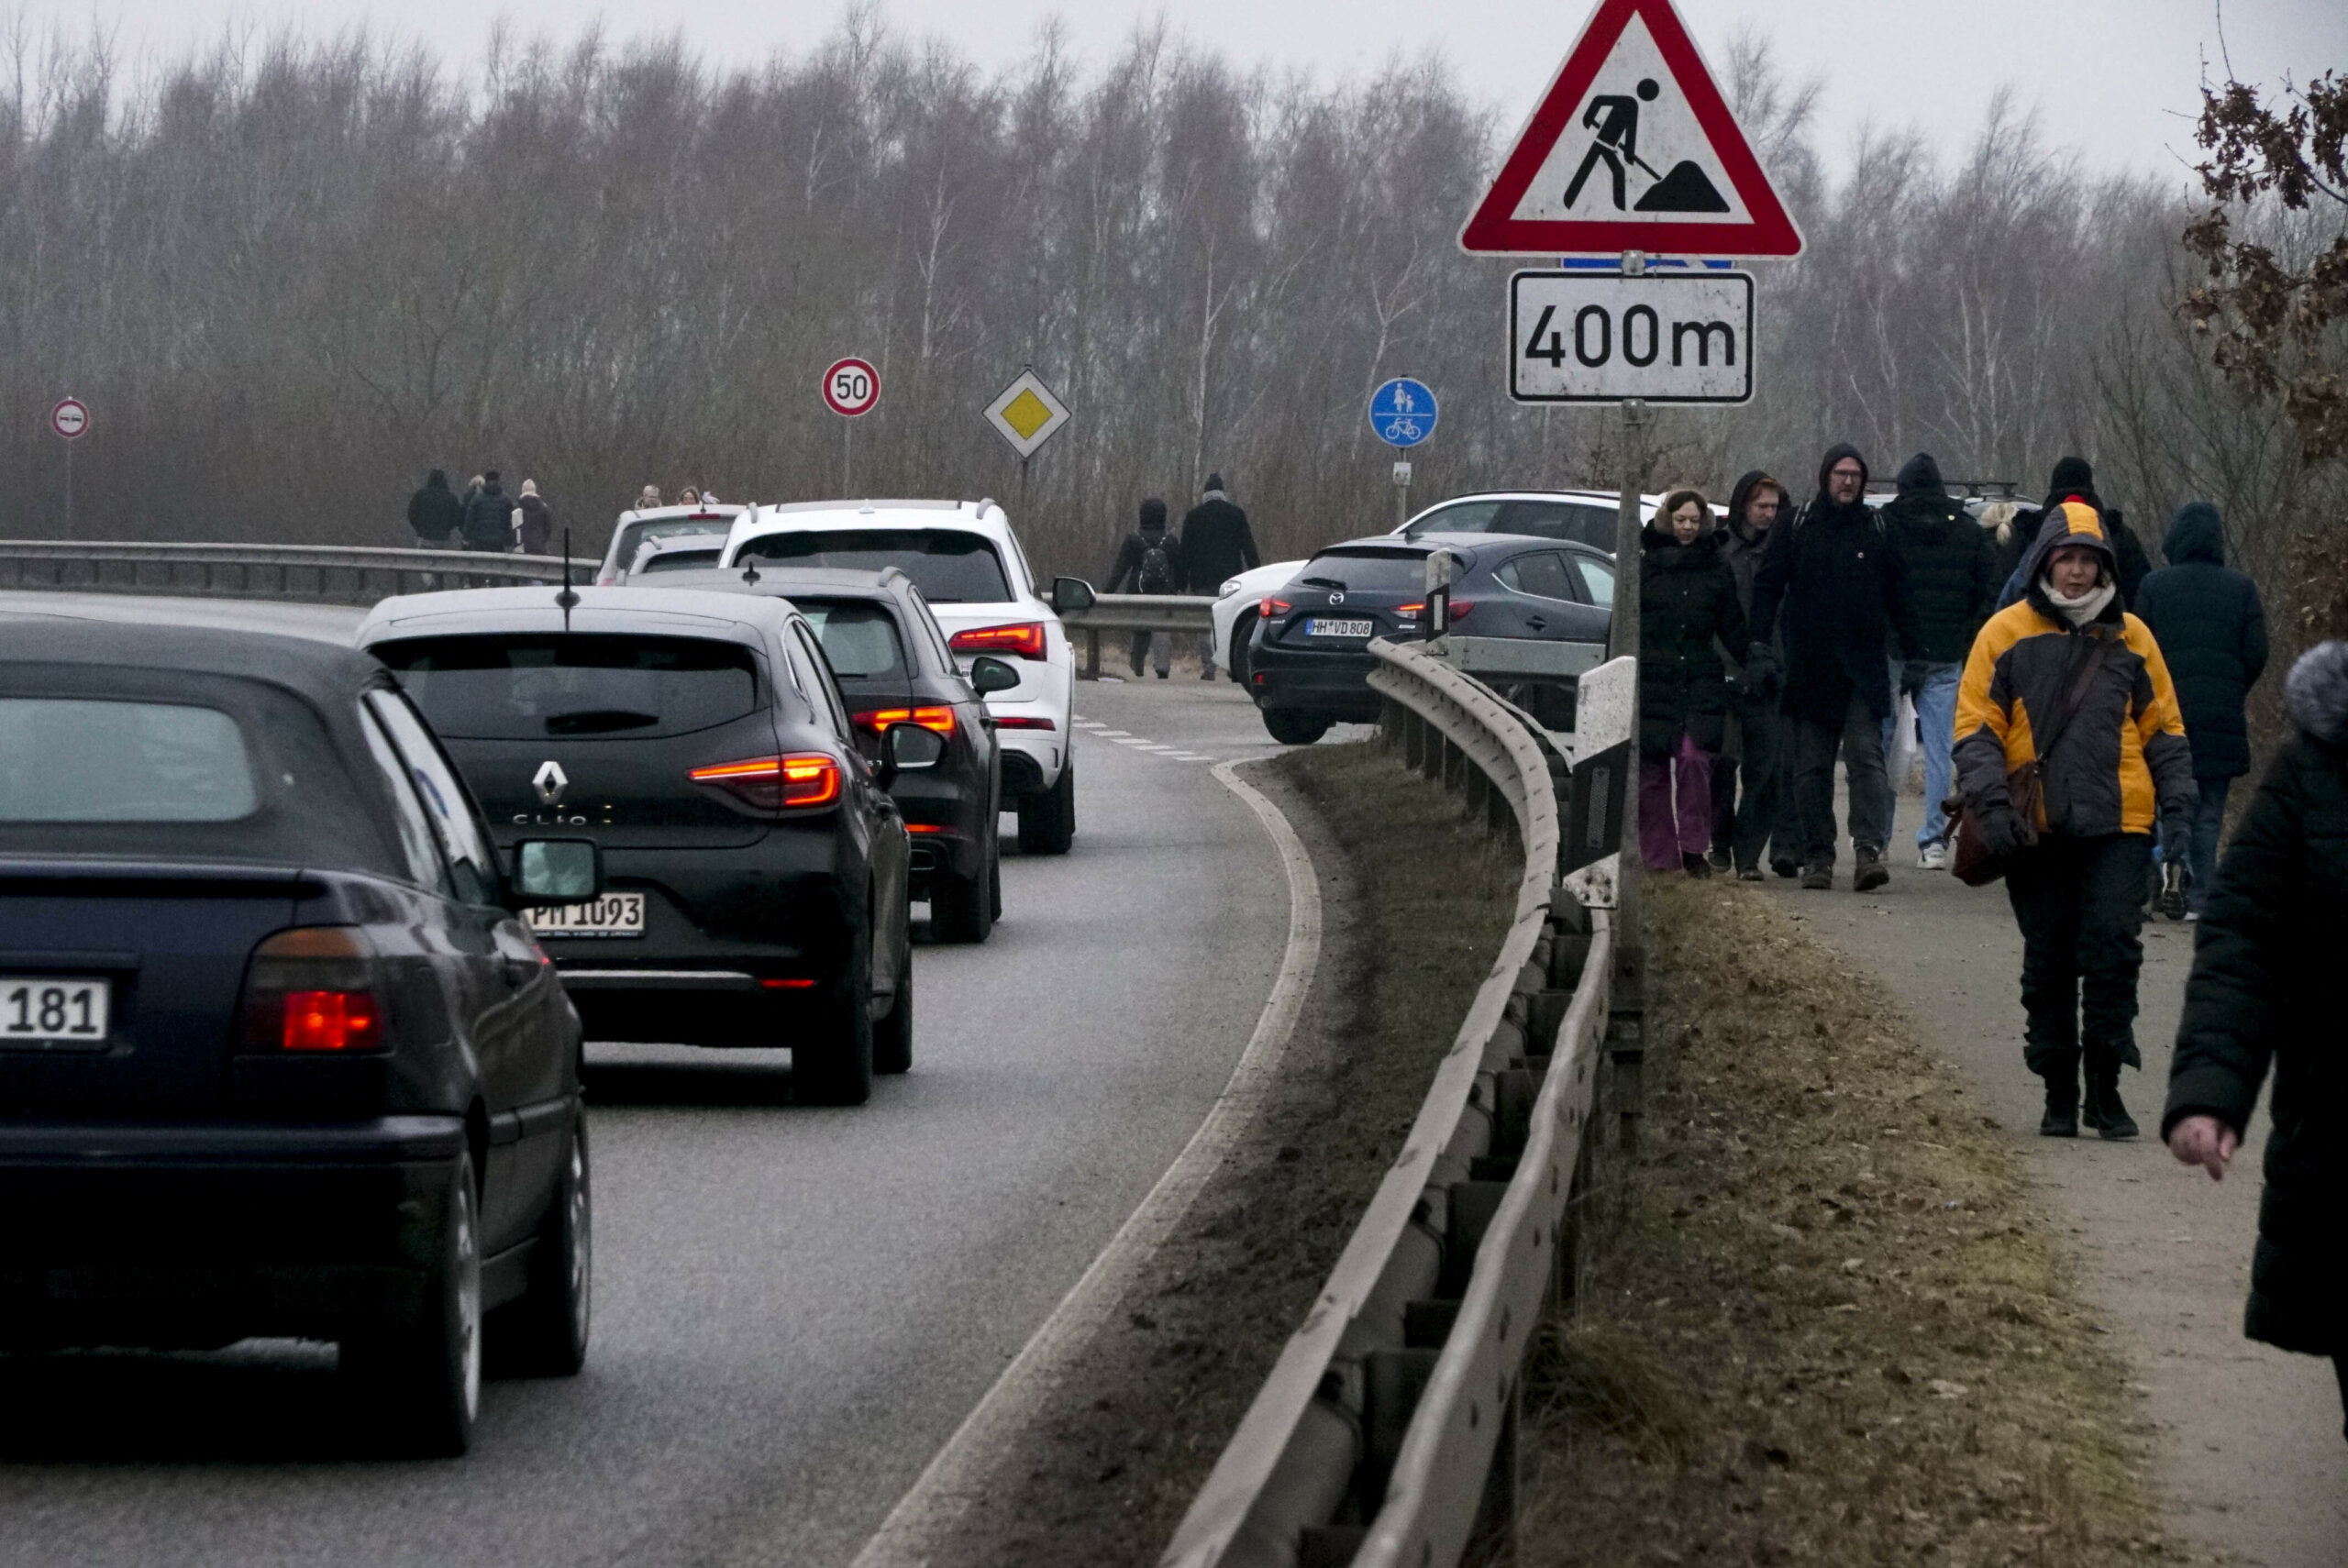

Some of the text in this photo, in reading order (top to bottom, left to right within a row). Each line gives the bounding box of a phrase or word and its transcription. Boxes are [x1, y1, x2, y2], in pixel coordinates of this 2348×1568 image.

[836, 374, 868, 400] 50
[1312, 621, 1370, 635] HH VD 808
[514, 814, 586, 825] CLIO
[573, 898, 640, 925] 1093
[7, 987, 97, 1034] 181
